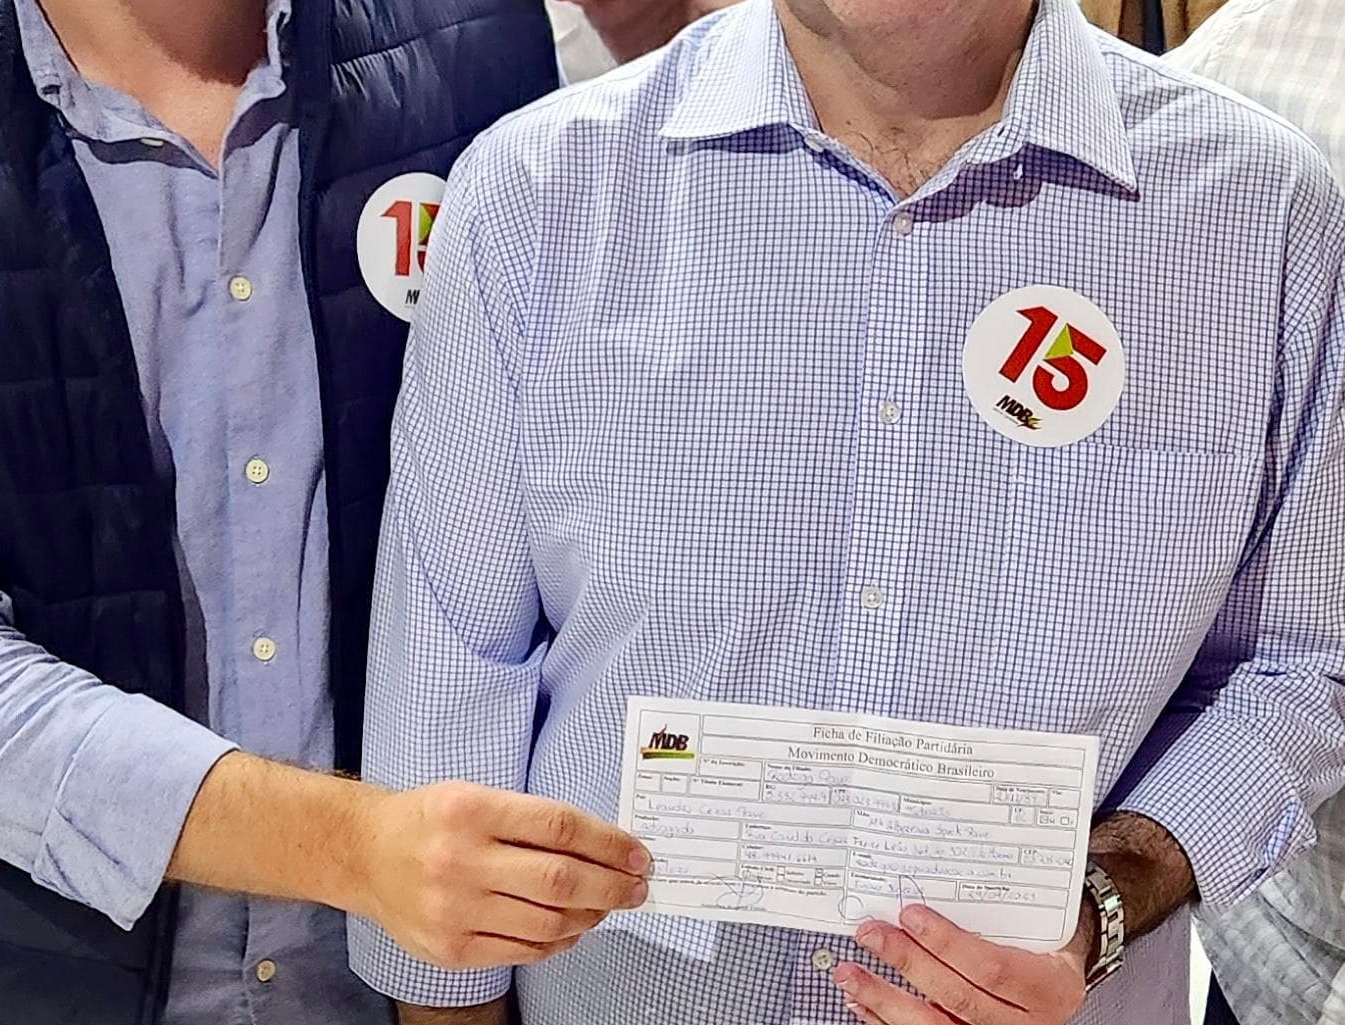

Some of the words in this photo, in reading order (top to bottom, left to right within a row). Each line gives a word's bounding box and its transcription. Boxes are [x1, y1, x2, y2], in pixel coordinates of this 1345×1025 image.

[998, 305, 1107, 411] 15
[995, 394, 1036, 425] MDB
[648, 731, 690, 751] MDB
[813, 726, 845, 740] Ficha
[848, 729, 862, 741] de
[865, 730, 913, 749] Filiação
[916, 737, 974, 756] Partidária
[787, 746, 855, 763] Movimento
[857, 751, 934, 773] Democrático
[936, 762, 995, 779] Brasileiro
